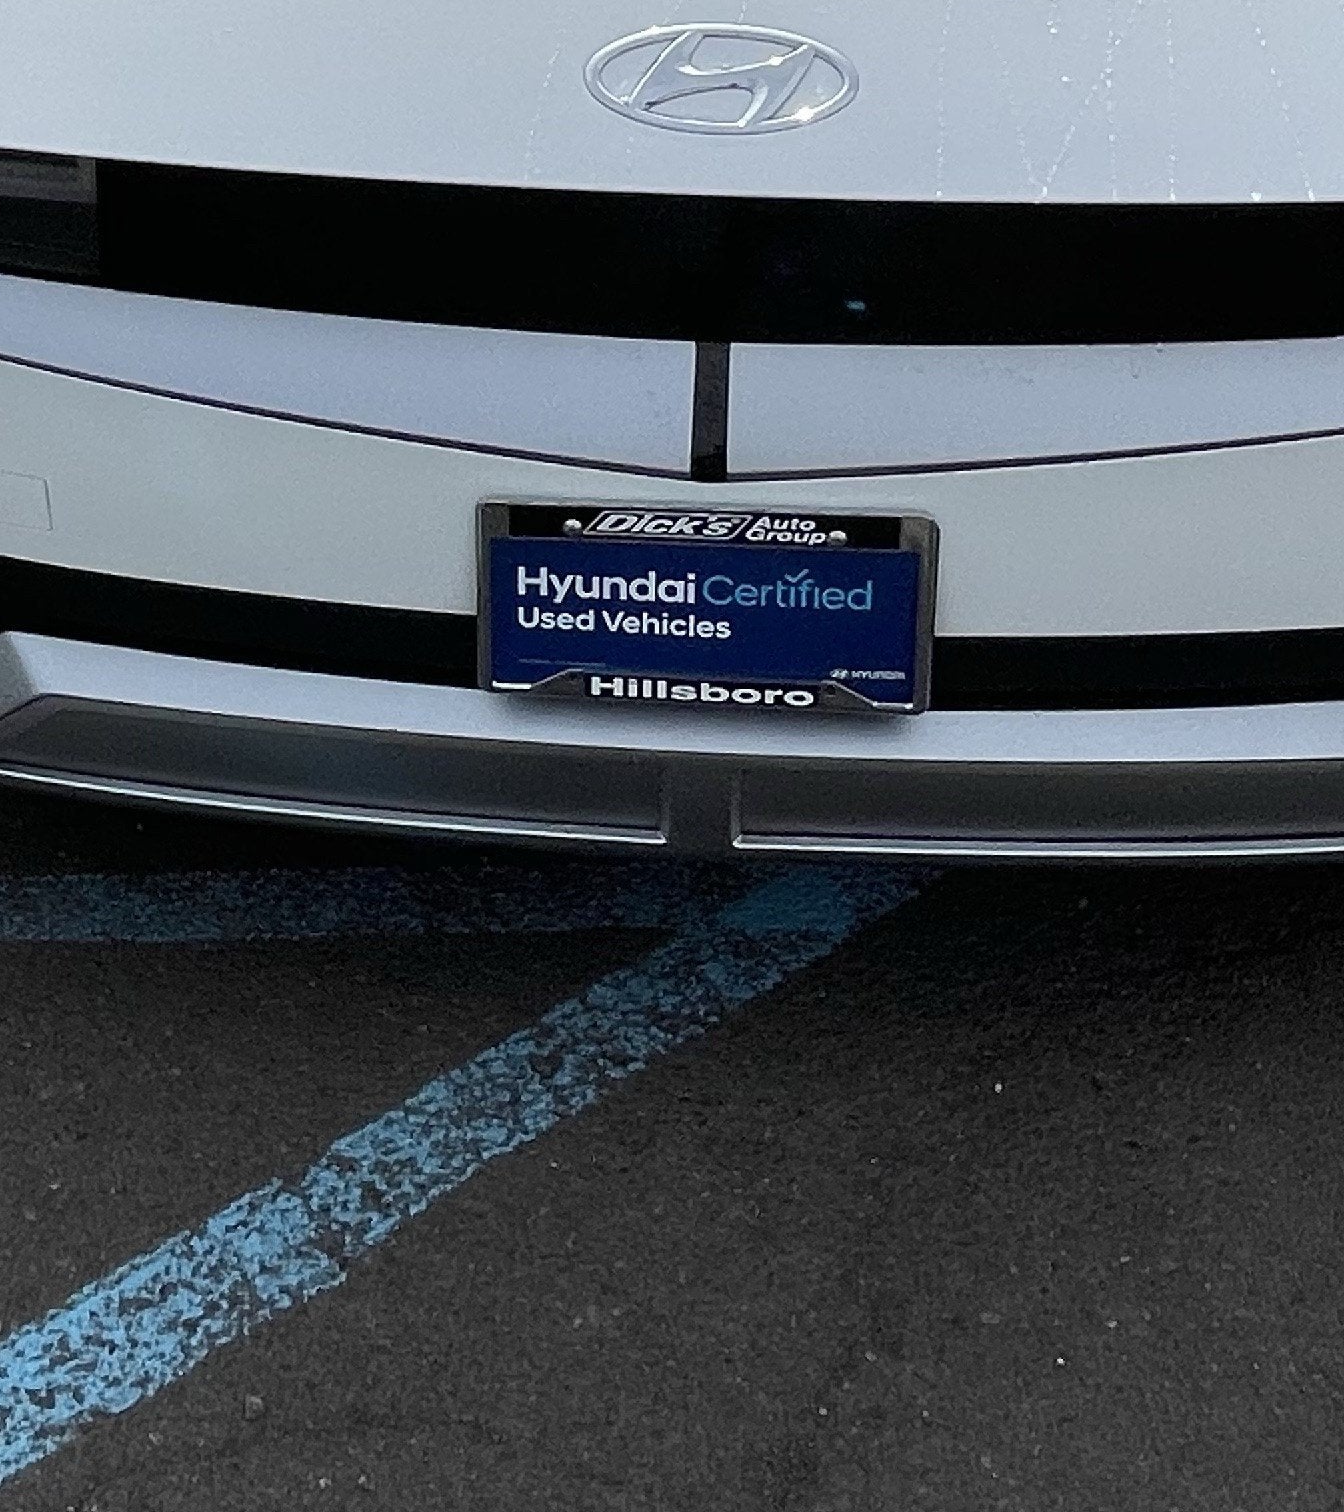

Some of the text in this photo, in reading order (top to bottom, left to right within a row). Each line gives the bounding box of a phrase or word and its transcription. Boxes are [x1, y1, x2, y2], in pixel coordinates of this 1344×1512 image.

[596, 514, 733, 536] Dick's
[751, 516, 816, 531] Auto
[745, 529, 827, 546] Group
[516, 566, 873, 611] Hyundai Certified
[517, 606, 732, 639] Used Vehicles
[589, 676, 815, 707] Hillsboro
